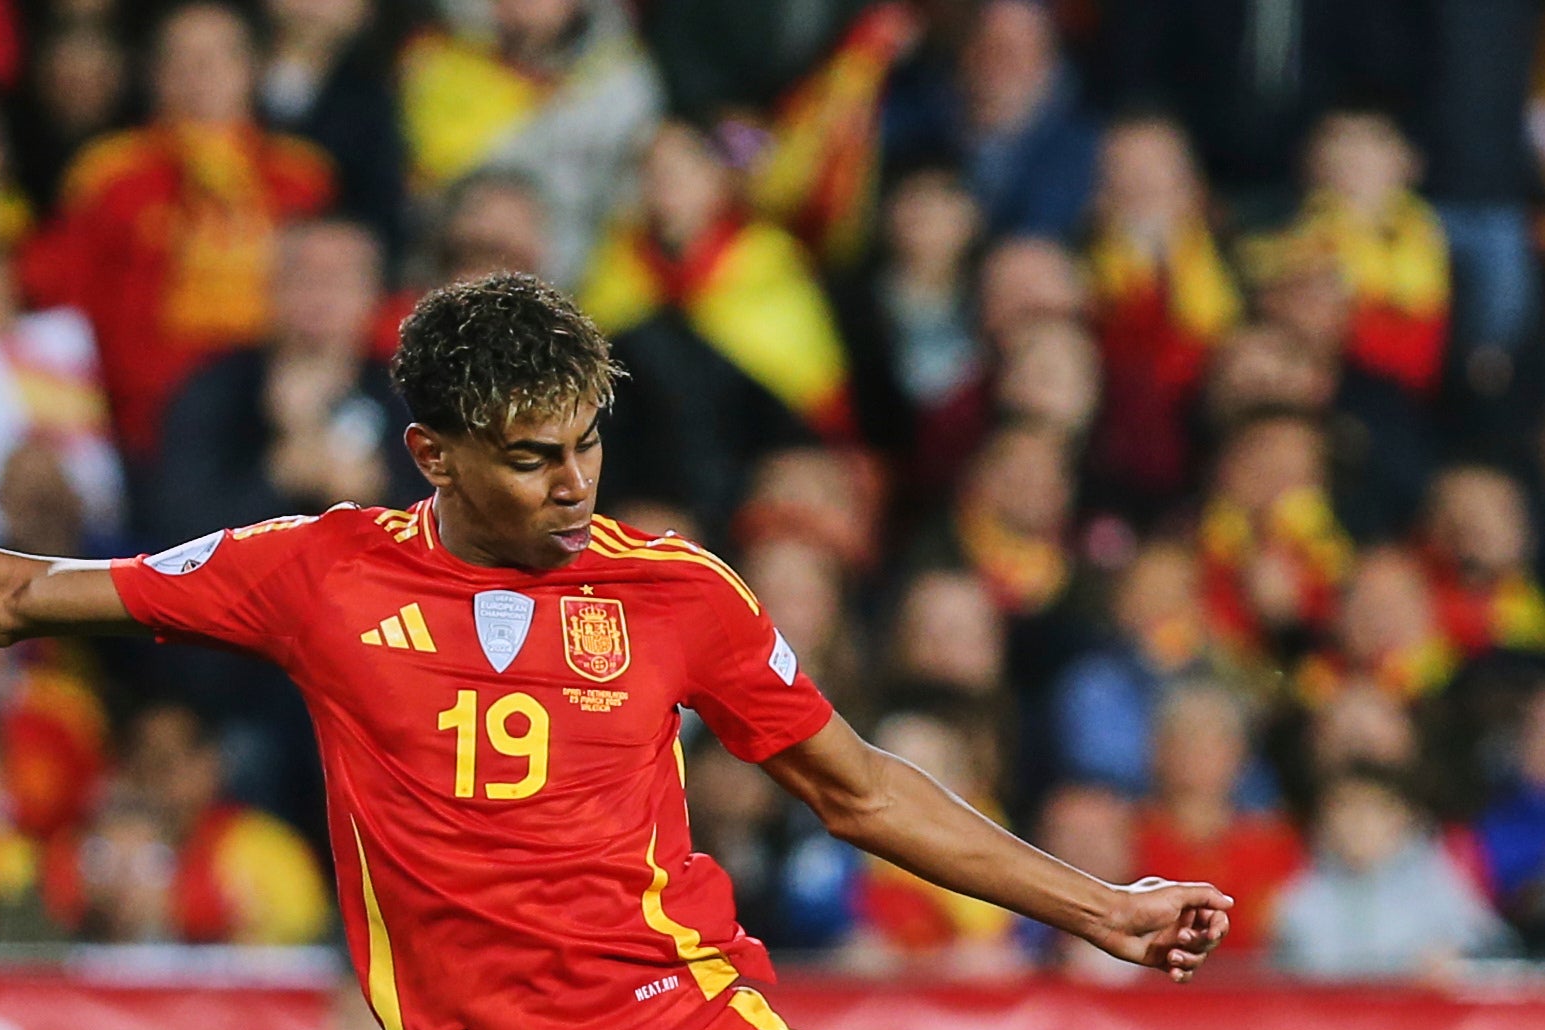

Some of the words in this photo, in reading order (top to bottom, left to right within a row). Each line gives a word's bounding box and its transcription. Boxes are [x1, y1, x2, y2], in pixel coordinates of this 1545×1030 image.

[480, 600, 528, 613] EUROPEAN
[479, 609, 527, 620] CHAMPIONS
[437, 688, 550, 800] 19
